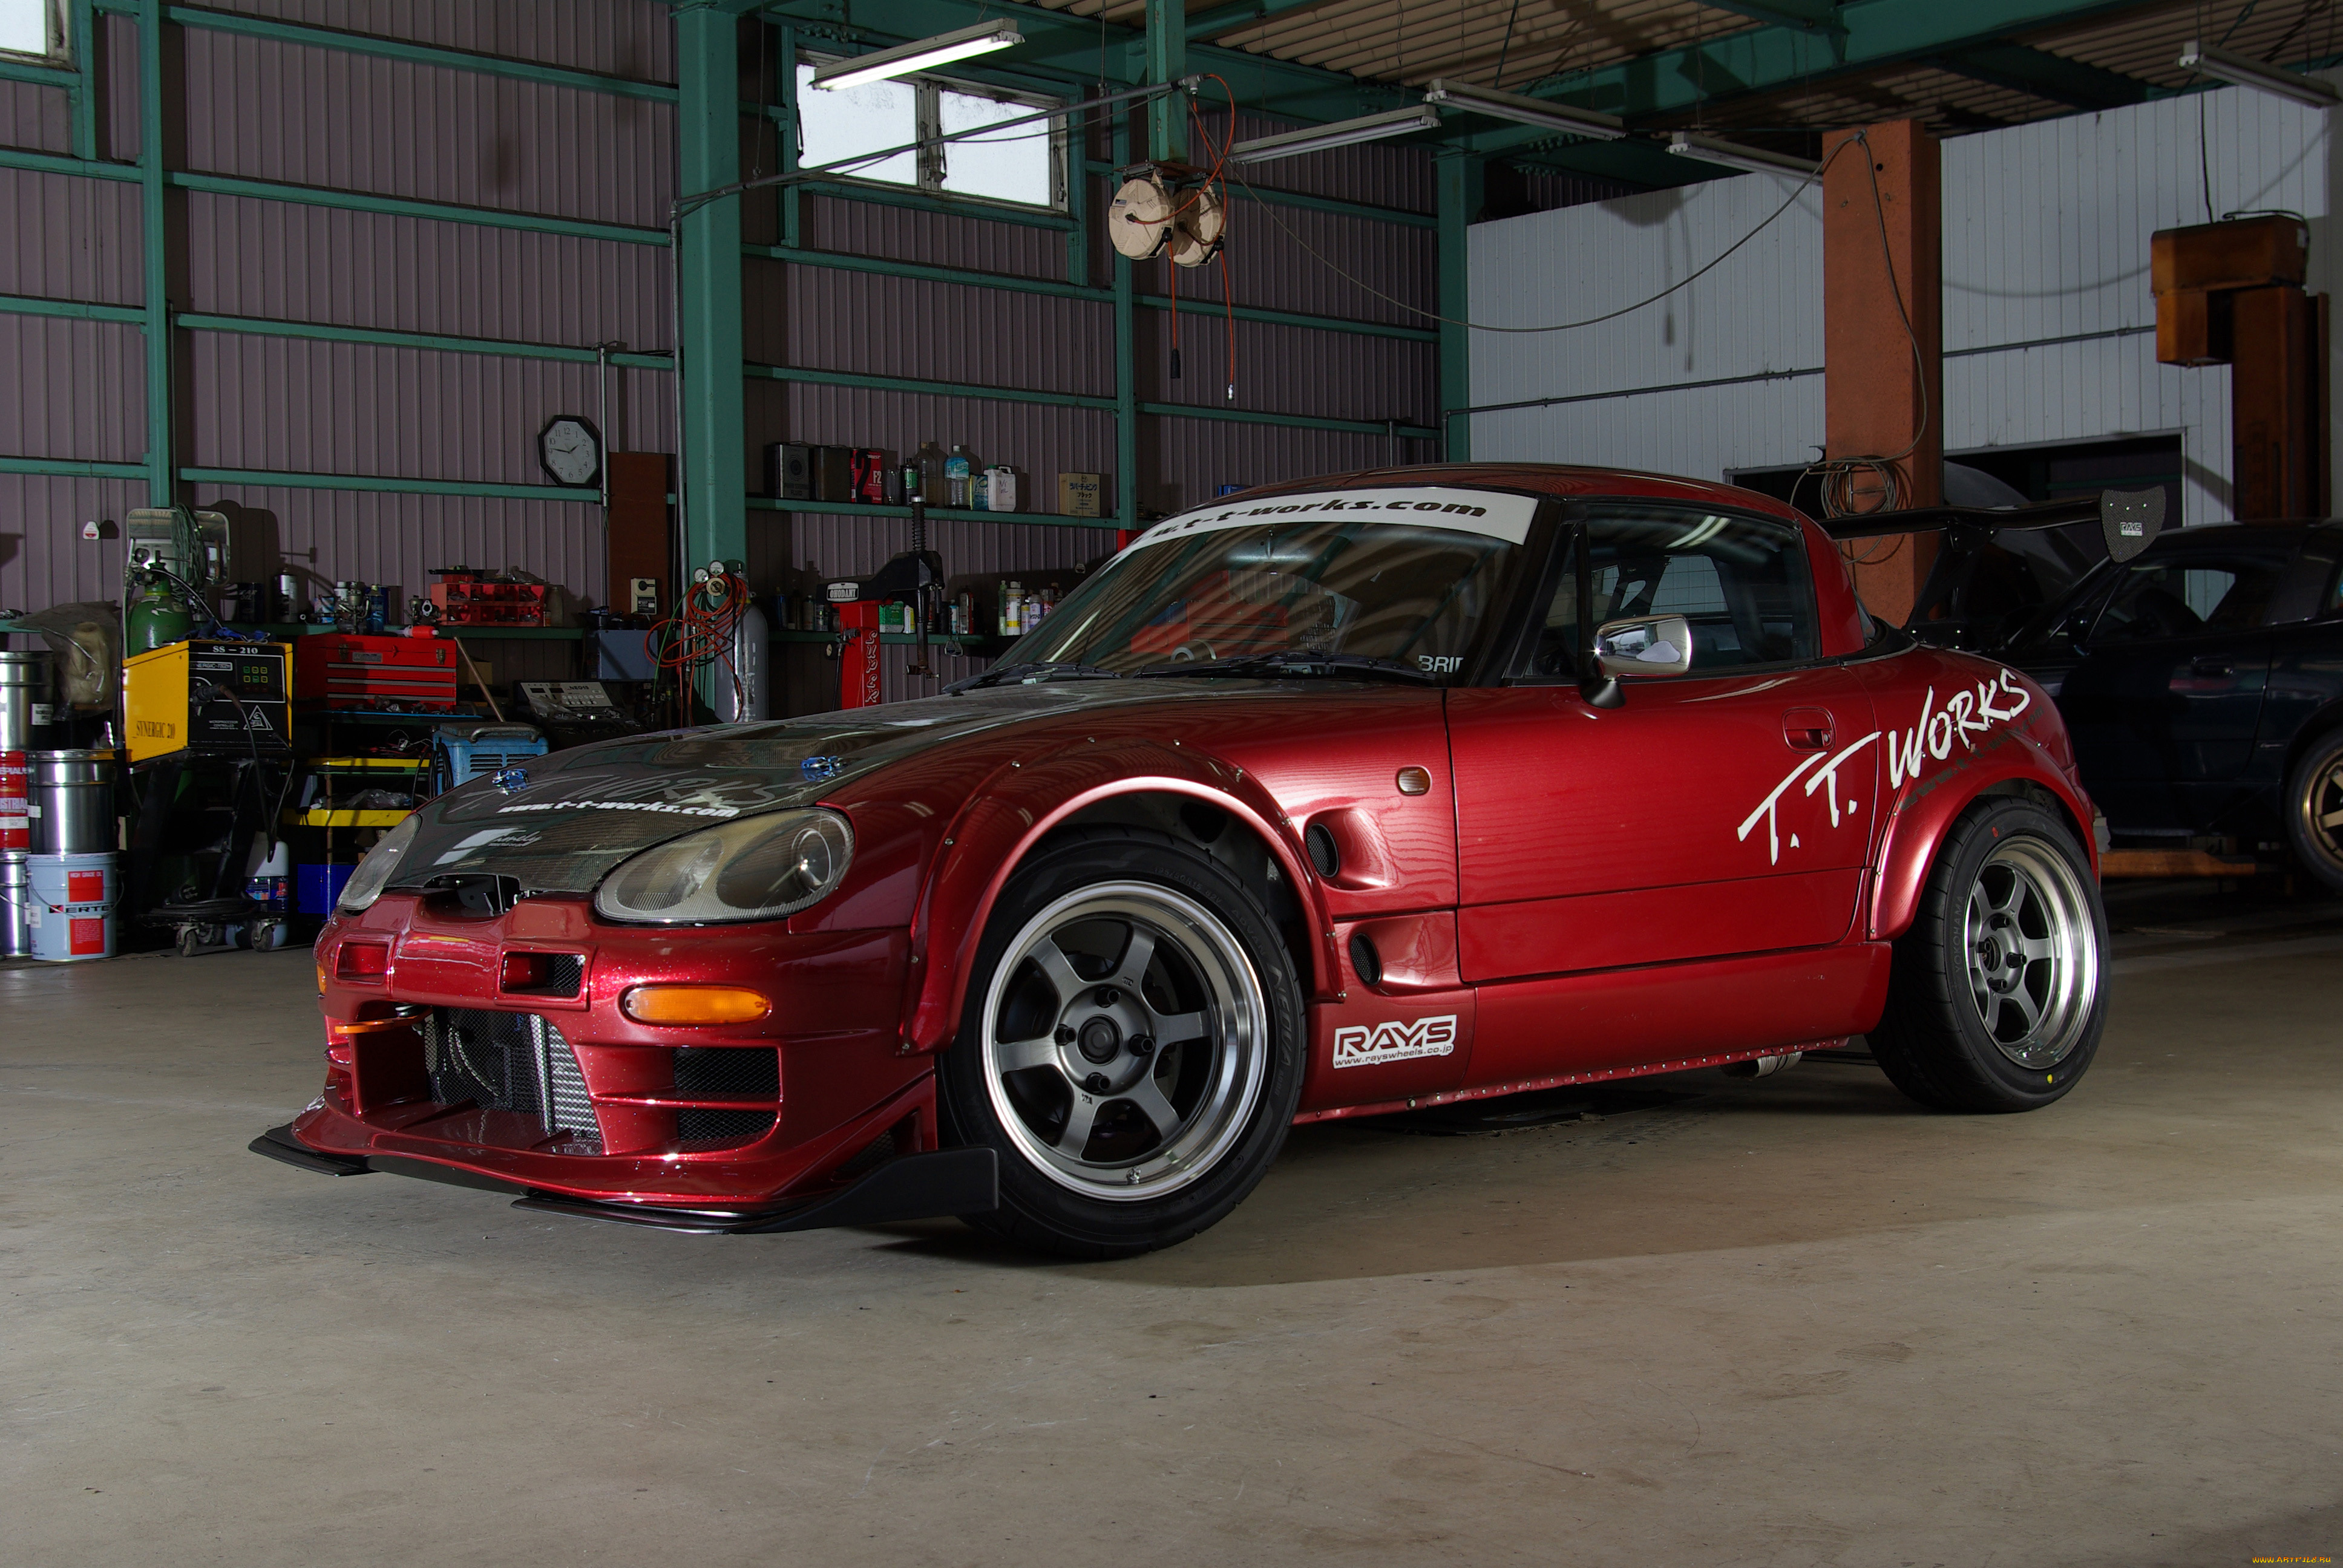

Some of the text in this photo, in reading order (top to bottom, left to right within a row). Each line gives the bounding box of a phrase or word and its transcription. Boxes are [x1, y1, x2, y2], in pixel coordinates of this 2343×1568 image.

[873, 470, 882, 484] F2
[2120, 523, 2142, 532] RAYS
[865, 630, 880, 704] SUPER
[1888, 668, 2031, 790] WORKS
[495, 799, 741, 818] www.t-t-works.com
[1953, 896, 1965, 973] YOKOHAMA
[1337, 1020, 1453, 1057] RAYS
[1334, 1044, 1452, 1067] www.rayswheels.co.jp
